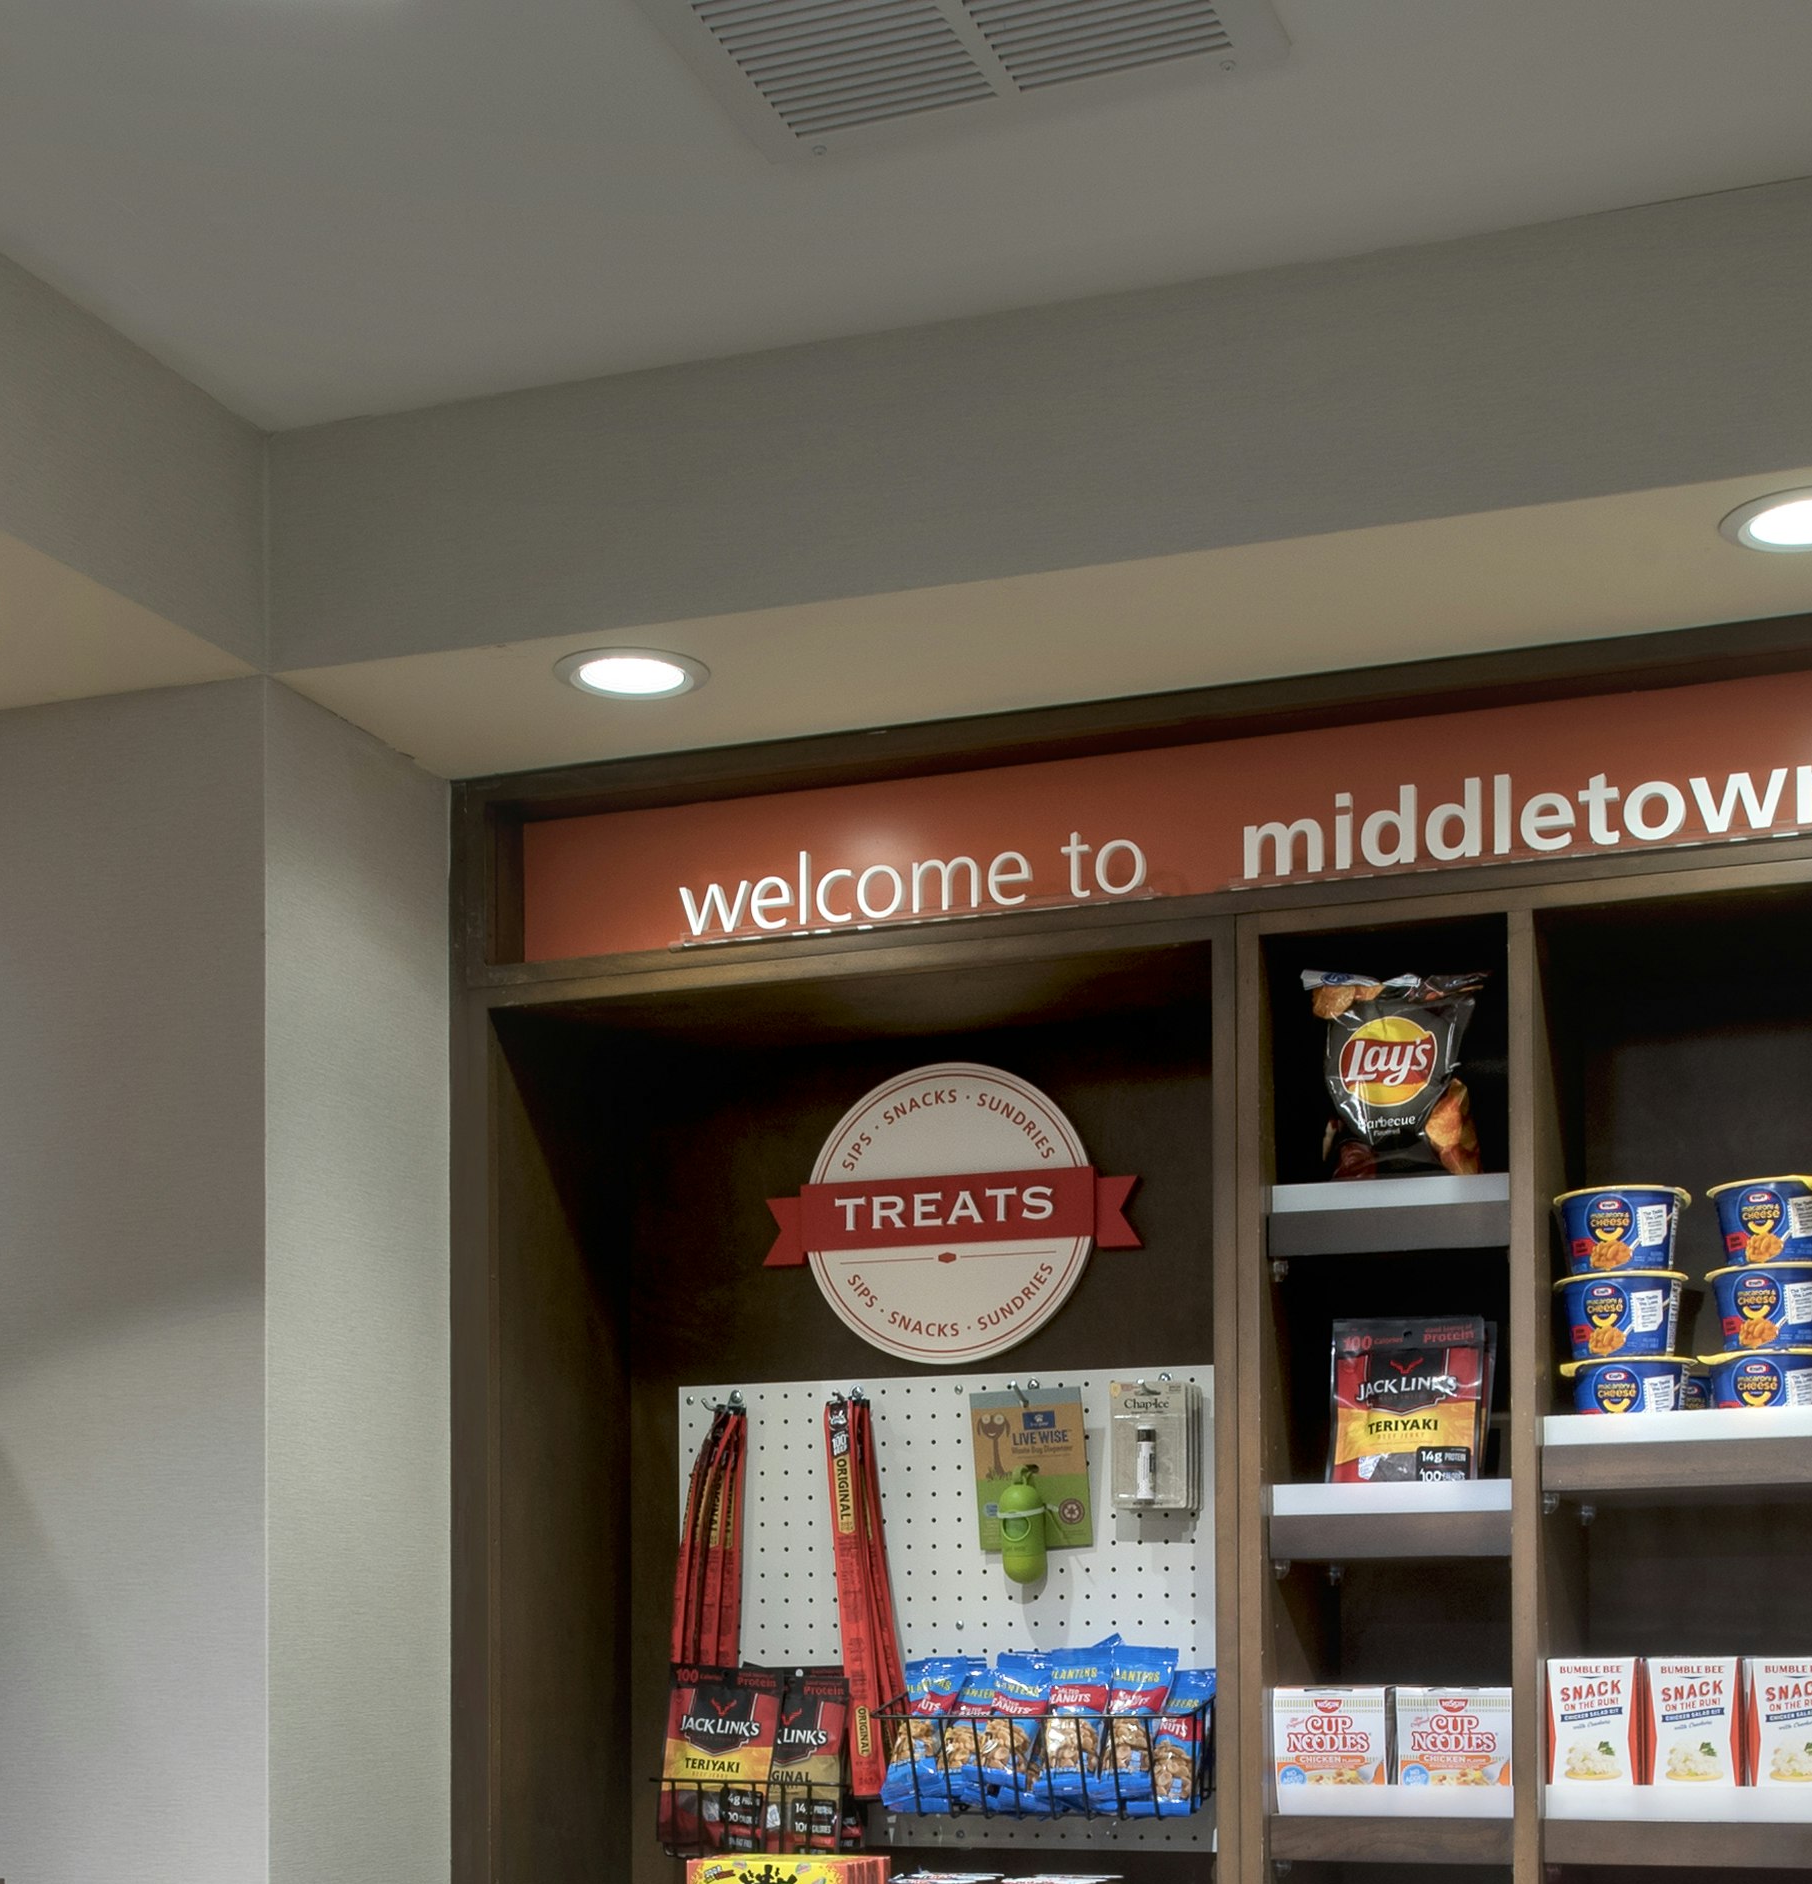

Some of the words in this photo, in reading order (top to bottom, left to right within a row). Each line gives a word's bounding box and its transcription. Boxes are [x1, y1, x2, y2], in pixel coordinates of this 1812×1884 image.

[679, 850, 1032, 936] welcome
[1061, 832, 1147, 897] to
[1345, 1038, 1431, 1086] Lay's
[842, 1132, 872, 1171] SIPS
[883, 1089, 957, 1125] SNACKS
[977, 1093, 1055, 1160] SUNDRIES
[835, 1186, 1054, 1231] TREATS
[847, 1274, 878, 1308] SIPS
[888, 1311, 960, 1337] SNACKS
[977, 1262, 1053, 1331] SUNDRIES
[1423, 1330, 1475, 1344] Protein
[1356, 1377, 1397, 1401] JACK
[1367, 1418, 1438, 1435] TERIYAKI
[1012, 1432, 1037, 1446] LIVE
[1038, 1429, 1069, 1444] WISE
[1420, 1451, 1443, 1464] 14g
[836, 1457, 851, 1521] ORIGINAL
[1559, 1664, 1601, 1674] BUMBLE
[1602, 1664, 1623, 1674] BEE
[1660, 1664, 1703, 1674] BUMBLE
[1703, 1664, 1725, 1674] BEE
[1763, 1664, 1807, 1674] BUMBLE
[1560, 1680, 1622, 1702] SNACK
[1661, 1680, 1724, 1702] SNACK
[1564, 1701, 1577, 1712] ON
[1597, 1697, 1620, 1708] RUN!
[1665, 1701, 1679, 1712] ON
[680, 1714, 714, 1732] JACK
[716, 1718, 761, 1737] LINK'S
[856, 1707, 871, 1755] ORIGINAL
[1305, 1716, 1354, 1734] CUP
[1429, 1716, 1479, 1734] CUP
[783, 1728, 828, 1746] LINK'S
[1287, 1731, 1371, 1753] NOODLES
[1412, 1731, 1497, 1753] NOODLES
[685, 1757, 740, 1774] TERIYAKI
[1299, 1755, 1341, 1764] CHICKEN
[1423, 1754, 1466, 1764] CHICKEN
